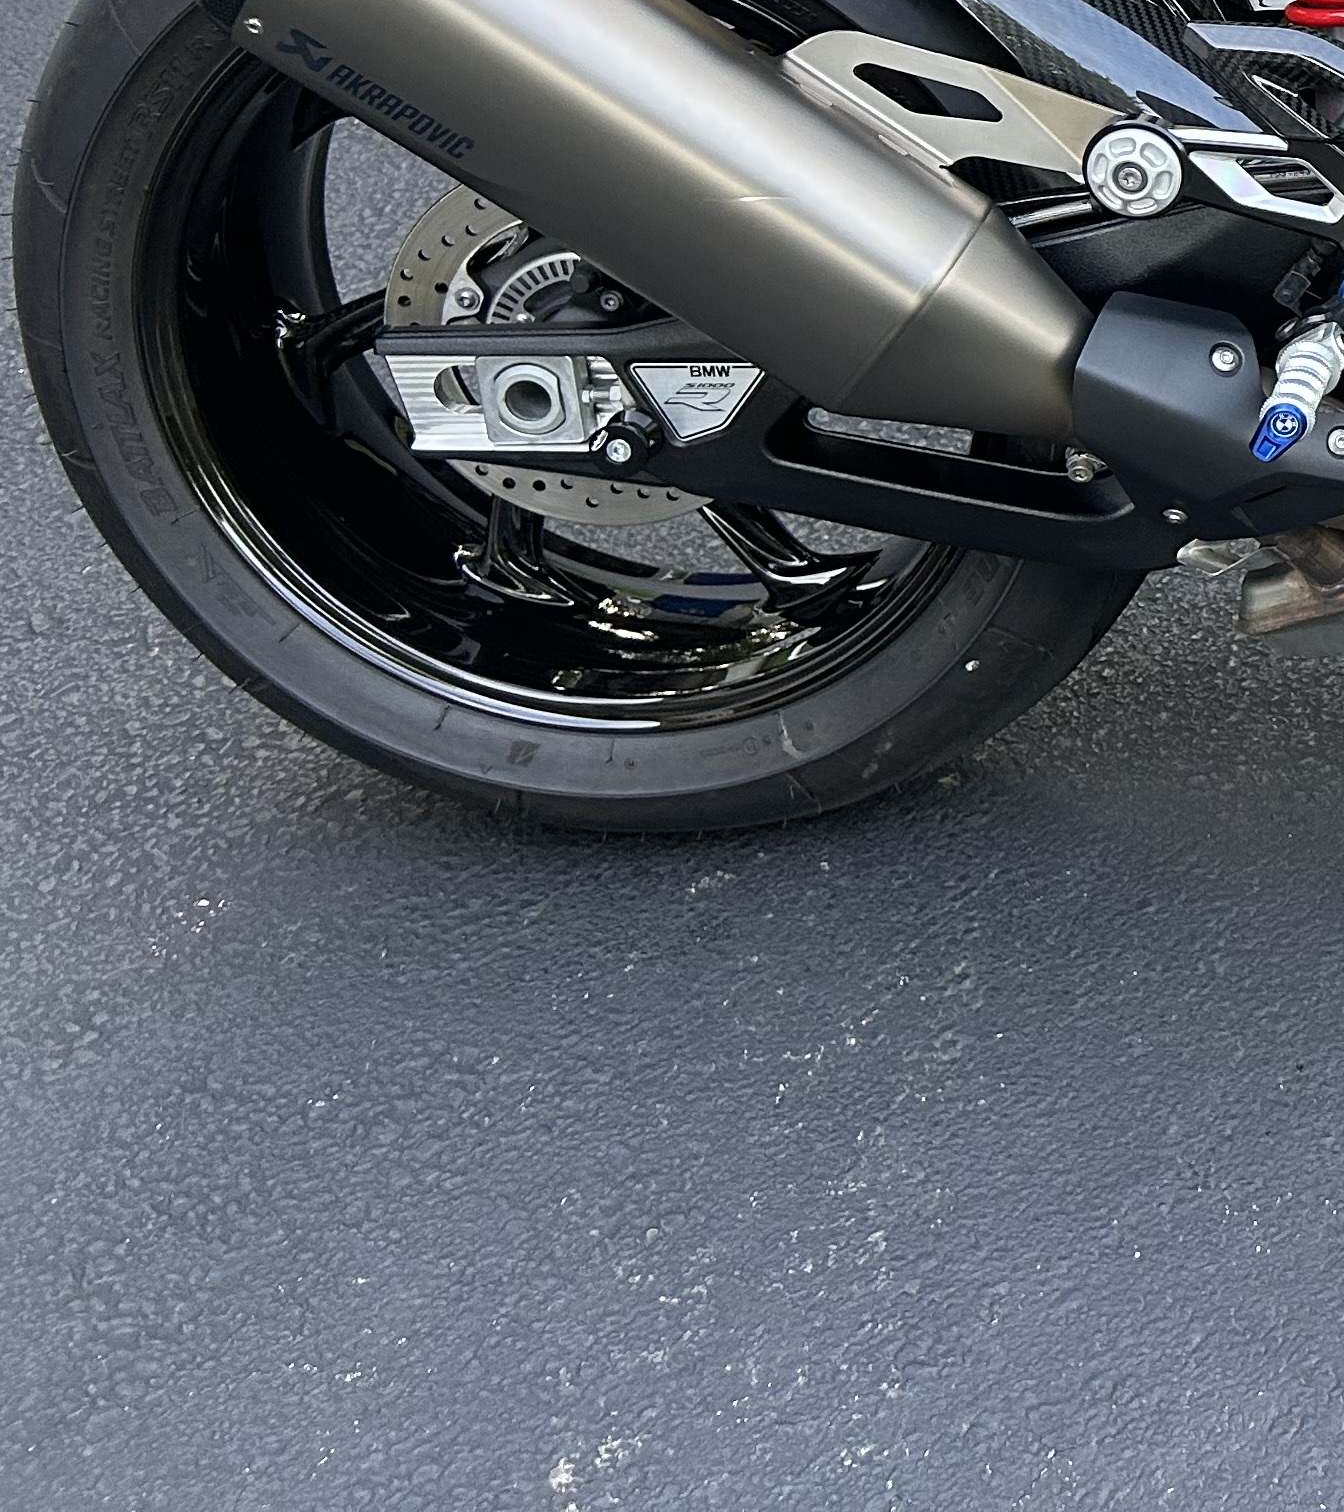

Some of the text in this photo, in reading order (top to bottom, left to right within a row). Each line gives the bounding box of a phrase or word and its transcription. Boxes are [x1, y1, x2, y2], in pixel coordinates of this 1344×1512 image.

[90, 239, 115, 342] RACING
[690, 366, 731, 377] BMW
[91, 347, 178, 521] BATTLAX
